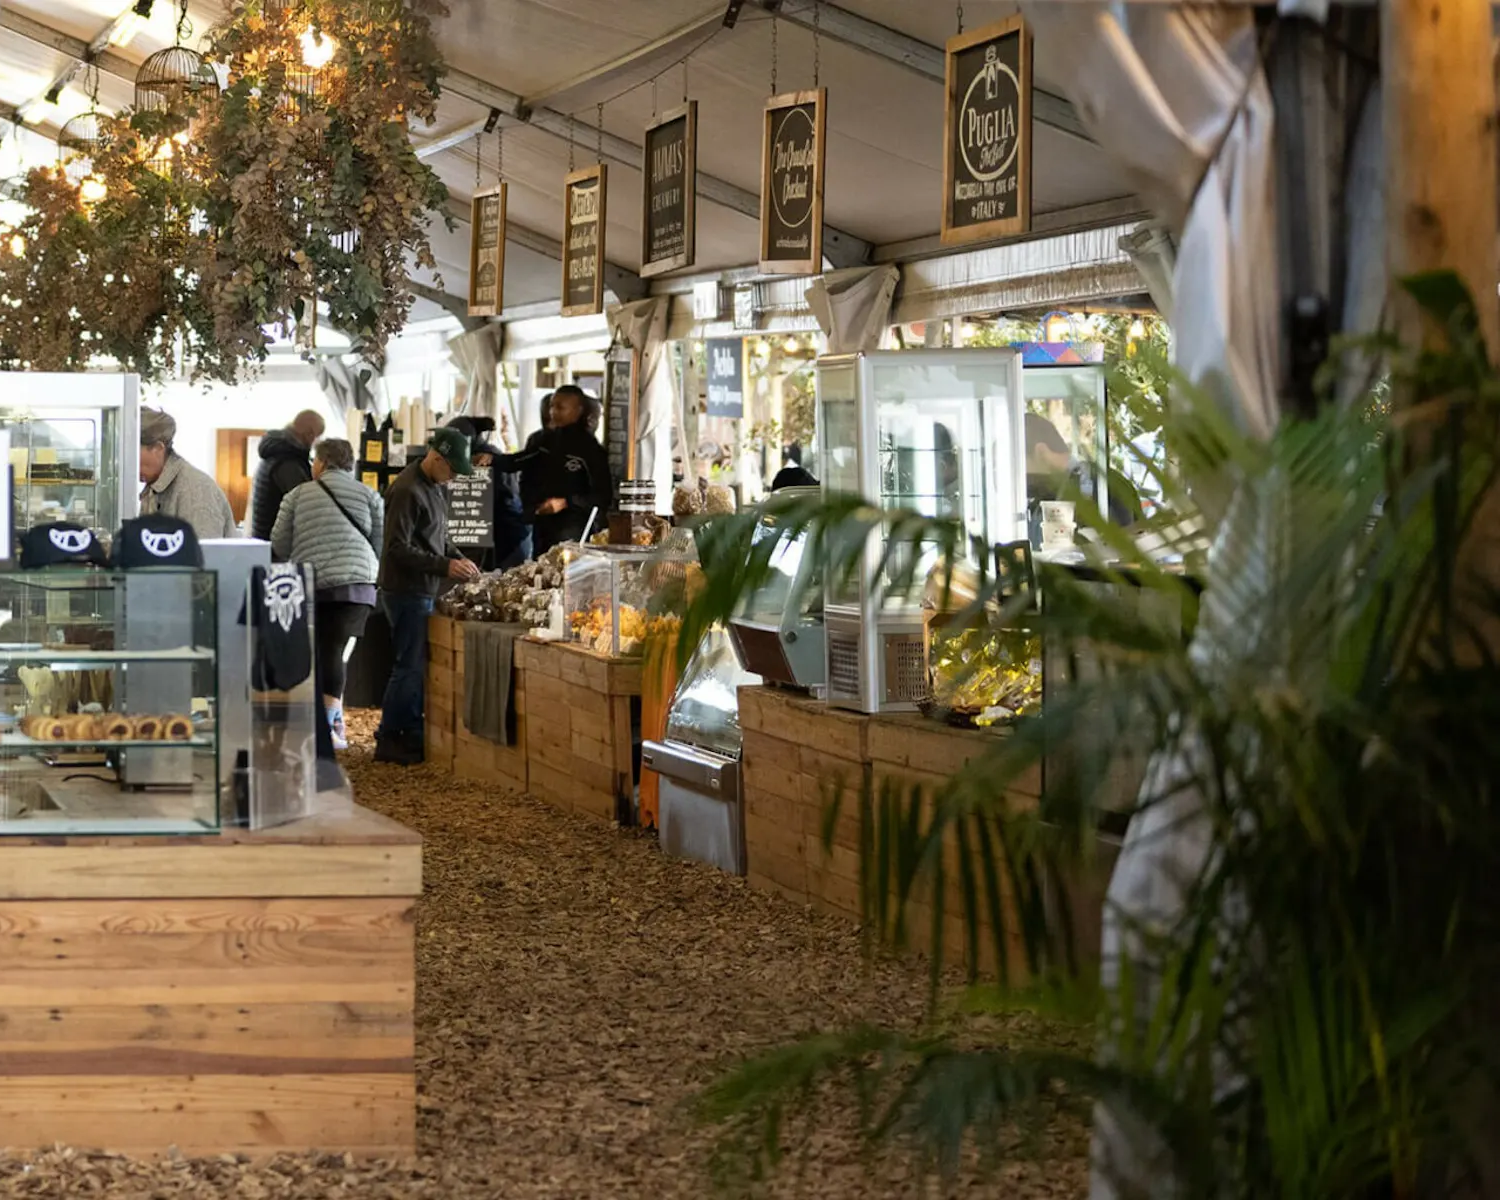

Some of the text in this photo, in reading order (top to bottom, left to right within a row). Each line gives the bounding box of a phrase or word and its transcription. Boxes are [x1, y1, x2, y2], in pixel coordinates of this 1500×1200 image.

[967, 103, 1016, 148] PUGLIA
[975, 200, 998, 220] ITALY
[451, 535, 479, 544] COFFEE
